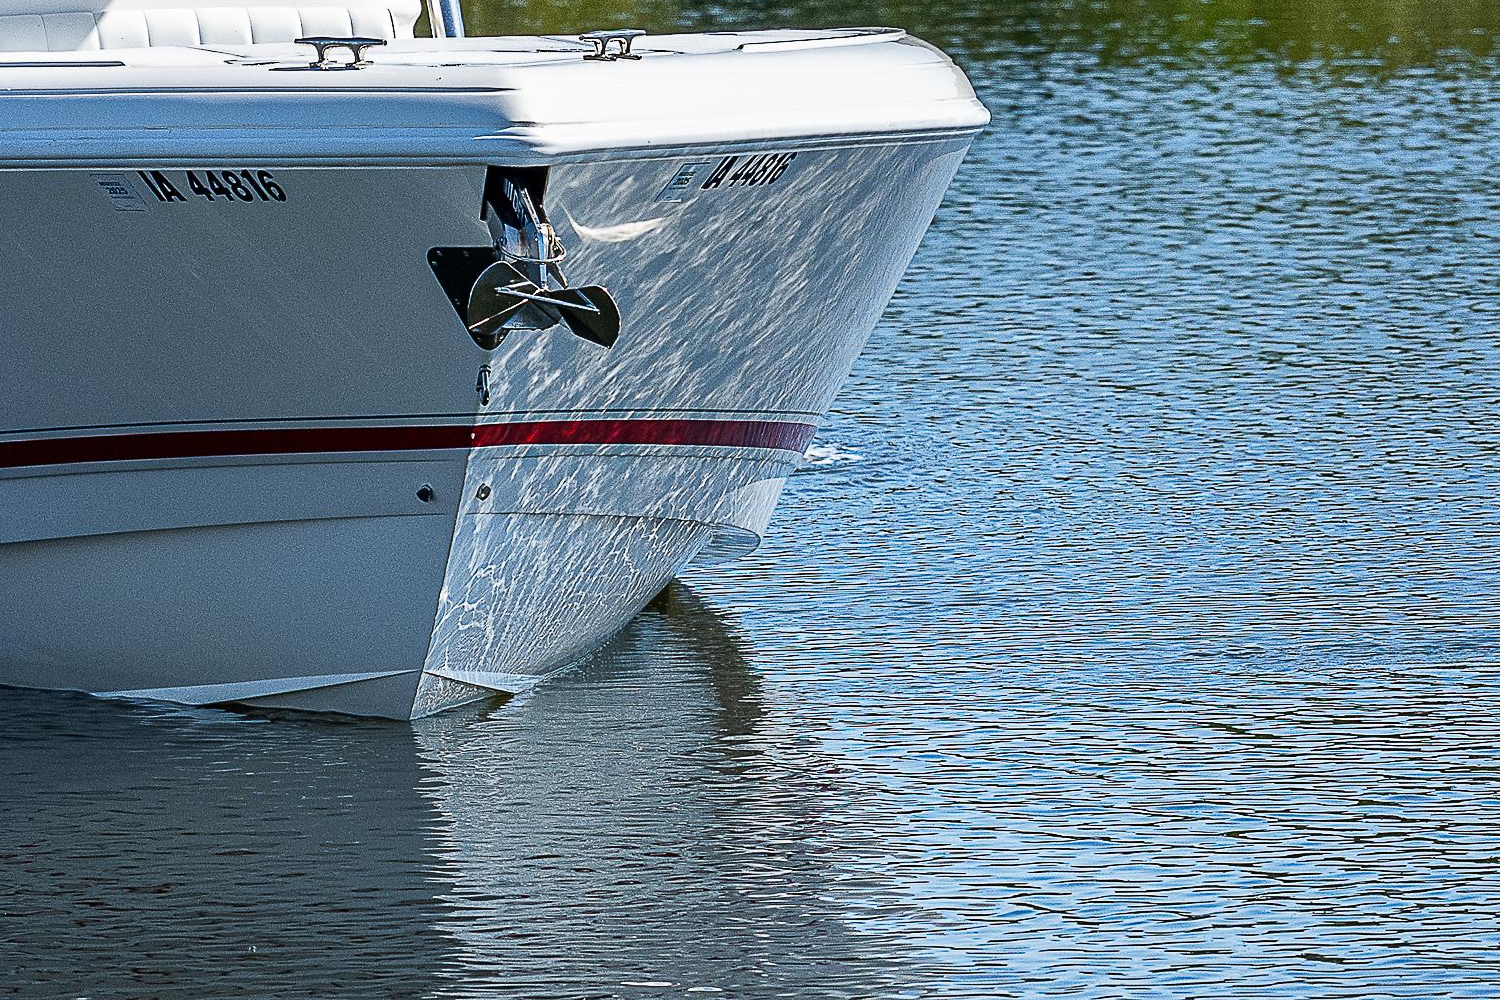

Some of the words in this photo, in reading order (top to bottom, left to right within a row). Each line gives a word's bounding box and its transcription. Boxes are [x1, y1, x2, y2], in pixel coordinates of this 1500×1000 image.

[136, 169, 188, 202] IA
[186, 169, 287, 202] 44816
[729, 152, 798, 187] 44816
